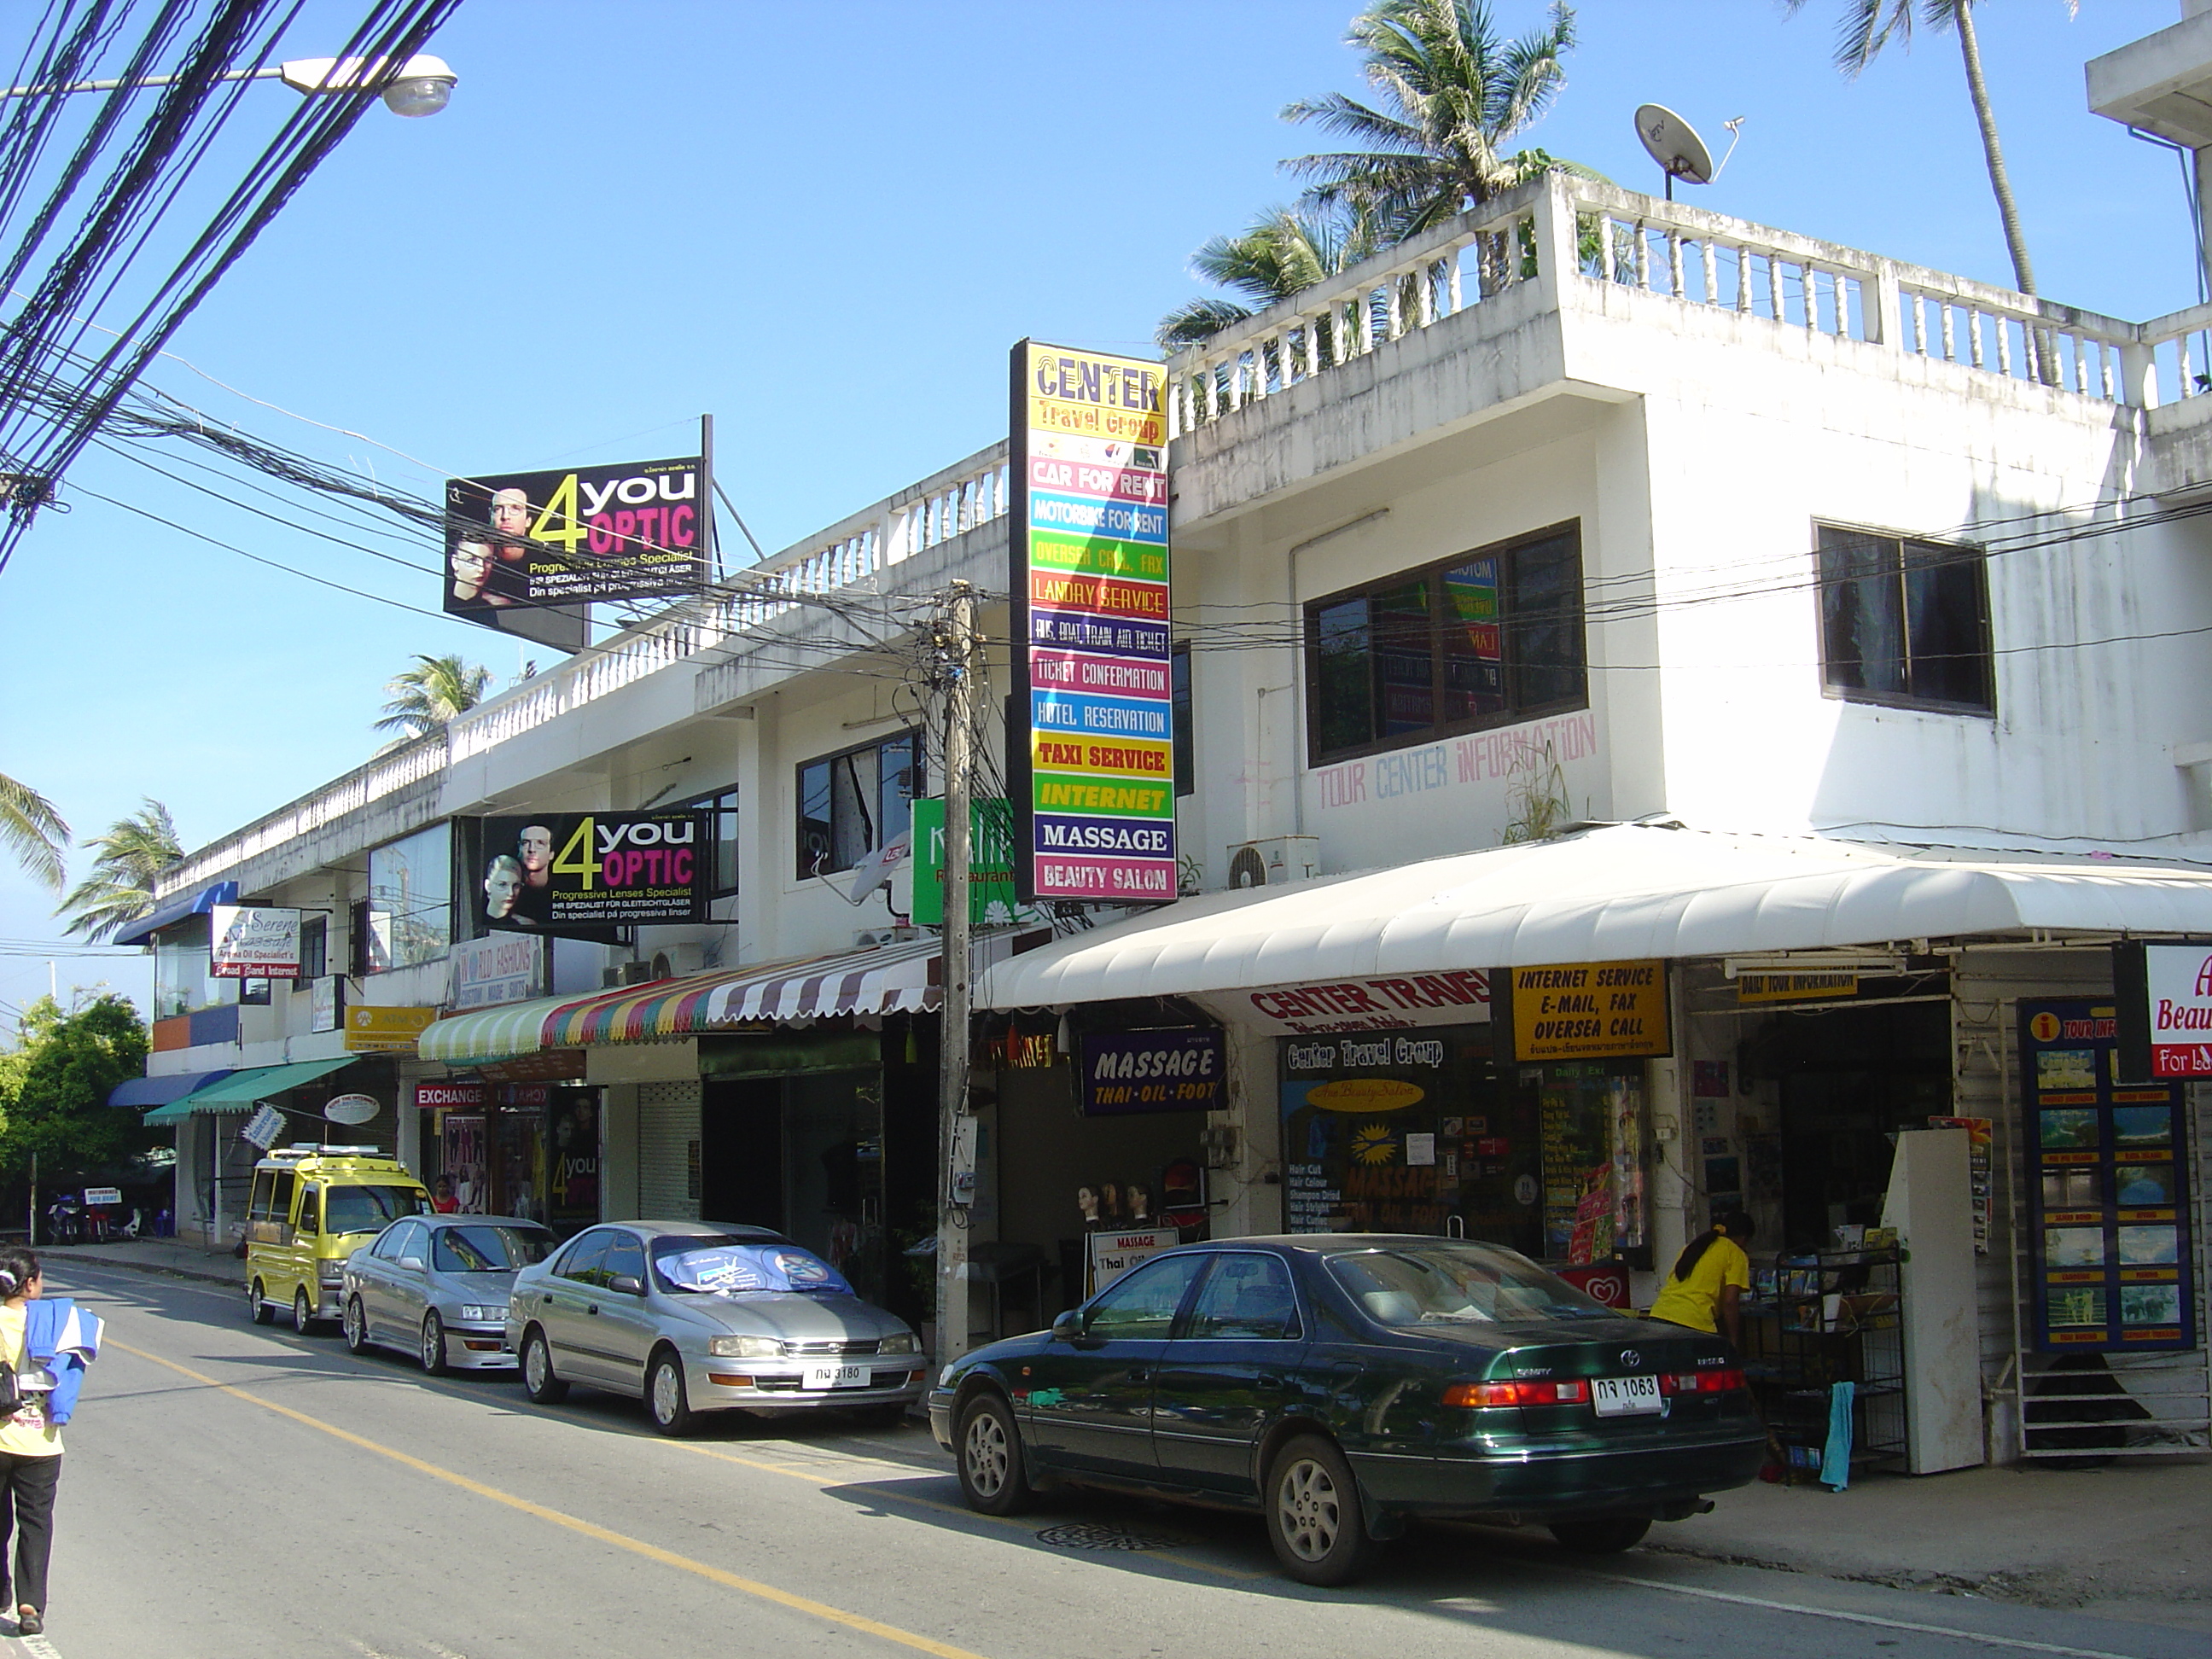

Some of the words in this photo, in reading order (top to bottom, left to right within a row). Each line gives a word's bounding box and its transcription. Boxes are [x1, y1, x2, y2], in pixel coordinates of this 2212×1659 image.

[1038, 356, 1160, 411] CENTER
[1039, 400, 1099, 431] Travel
[1106, 410, 1160, 444] Group
[1033, 461, 1073, 486] CAR
[1078, 468, 1114, 492] FOR
[1121, 474, 1165, 498] RENT
[1034, 499, 1105, 527] MOTORBIKE
[1109, 509, 1131, 530] FOR
[1135, 513, 1163, 534] RENT
[589, 504, 695, 555] OPTIC
[639, 550, 693, 564] Specialist
[1036, 542, 1091, 565] OVERSEA
[1141, 554, 1163, 574] FAX
[529, 586, 545, 597] Din
[1035, 578, 1096, 604] LANDRY
[1100, 586, 1164, 613] SERVICE
[1116, 627, 1132, 648] AIR
[1135, 630, 1166, 652] TICKET
[1037, 658, 1075, 682] TICKET
[1082, 663, 1165, 691] CONFERMATION
[1038, 701, 1077, 725] HOTEL
[1084, 706, 1164, 733] RESERVATION
[1039, 742, 1082, 765] TAXI
[1089, 746, 1166, 771] SERVICE
[1317, 763, 1365, 809] TOUR
[1376, 745, 1447, 799] CENTER
[1041, 783, 1166, 811] INTERNET
[1043, 824, 1167, 851] MASSAGE
[603, 848, 694, 886] OPTIC
[935, 869, 1015, 883] Raurant
[1044, 864, 1107, 888] BEAUTY
[1113, 868, 1167, 890] SALON
[552, 890, 607, 901] Progressive
[610, 888, 643, 899] Lenses
[646, 888, 692, 898] Specialist
[252, 911, 297, 932] Serene
[552, 911, 566, 920] Din
[620, 909, 667, 920] progressiva
[268, 965, 298, 975] Internet
[1518, 969, 1589, 989] INTERNET
[1596, 968, 1654, 987] SERVICE
[1249, 982, 1380, 1019] CENTER
[1540, 993, 1600, 1016] E-MAIL,
[1610, 992, 1637, 1011] FAX
[383, 1014, 408, 1024] ATM
[1534, 1018, 1604, 1040] OVERSEA
[1610, 1017, 1644, 1038] CALL
[2064, 1020, 2093, 1039] TOUR
[2095, 1019, 2118, 1039] INF
[1094, 1049, 1214, 1080] MASSAGE
[1288, 1043, 1335, 1068] Center
[1341, 1038, 1390, 1067] Travel
[1396, 1038, 1443, 1068] Group
[2159, 1049, 2187, 1072] For
[1555, 1067, 1580, 1078] Daily
[418, 1089, 482, 1103] EXCHANGE
[1095, 1086, 1131, 1104] THAI
[1141, 1085, 1167, 1103] OIL
[1177, 1081, 1216, 1100] FOOT
[1289, 1164, 1305, 1175] Hair
[1307, 1164, 1322, 1175] Cut
[1289, 1177, 1303, 1188] Hair
[1305, 1177, 1328, 1188] Colour
[1289, 1202, 1304, 1213] Hair
[1289, 1214, 1304, 1225] Hair
[1117, 1236, 1155, 1249] MASSAGE
[1099, 1257, 1124, 1270] Thai
[835, 1367, 859, 1379] 3180
[1623, 1378, 1655, 1397] 1063
